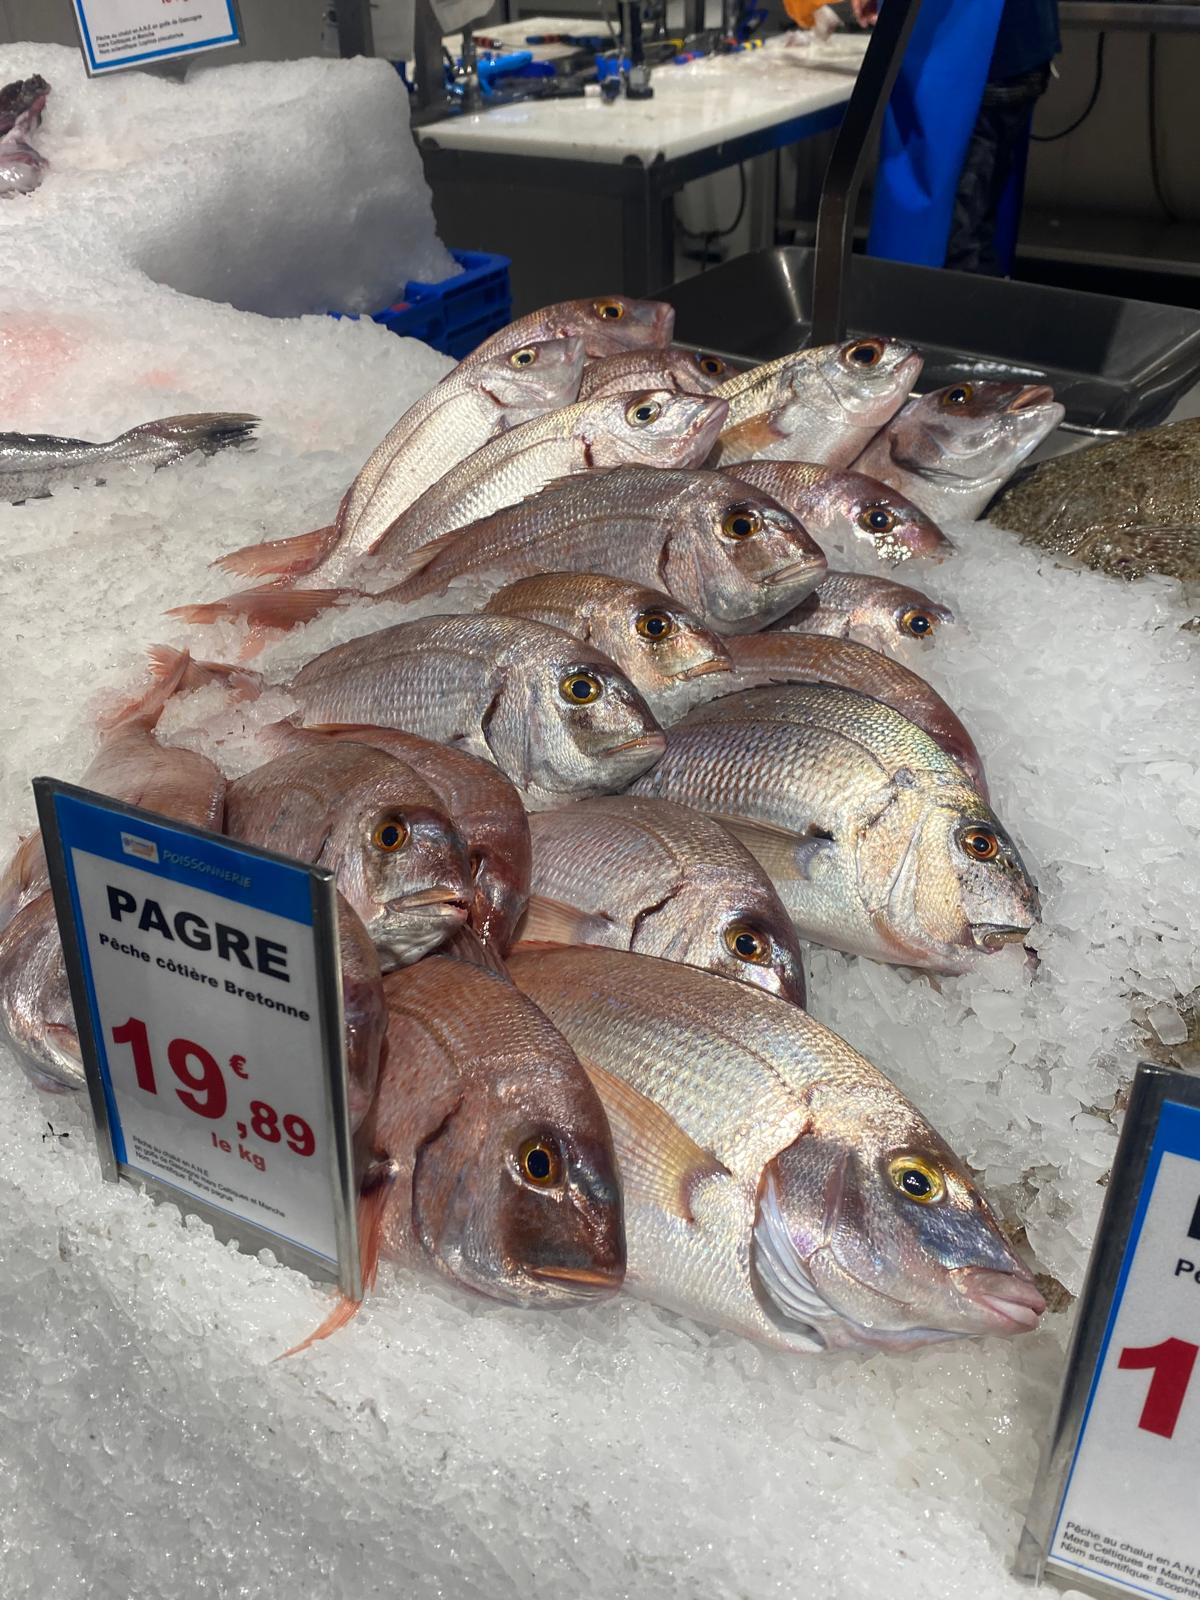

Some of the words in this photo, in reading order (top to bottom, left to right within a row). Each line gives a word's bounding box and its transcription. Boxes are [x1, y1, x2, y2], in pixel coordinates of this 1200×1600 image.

[162, 849, 252, 888] POISSONNERIE
[106, 885, 290, 983] PAGRE
[99, 933, 151, 962] Pêche
[156, 957, 219, 988] côtière
[224, 980, 310, 1022] Bretonne
[112, 1016, 228, 1120] 19
[211, 1132, 232, 1153] le
[239, 1144, 267, 1172] kg
[1060, 1541, 1086, 1558] Nom
[1063, 1531, 1090, 1548] Mers
[1093, 1542, 1143, 1569] Celtiques
[1147, 1563, 1157, 1573] et
[1066, 1521, 1101, 1541] Pêche
[1103, 1536, 1117, 1547] au
[1120, 1543, 1154, 1561] chalut
[1156, 1556, 1170, 1567] en
